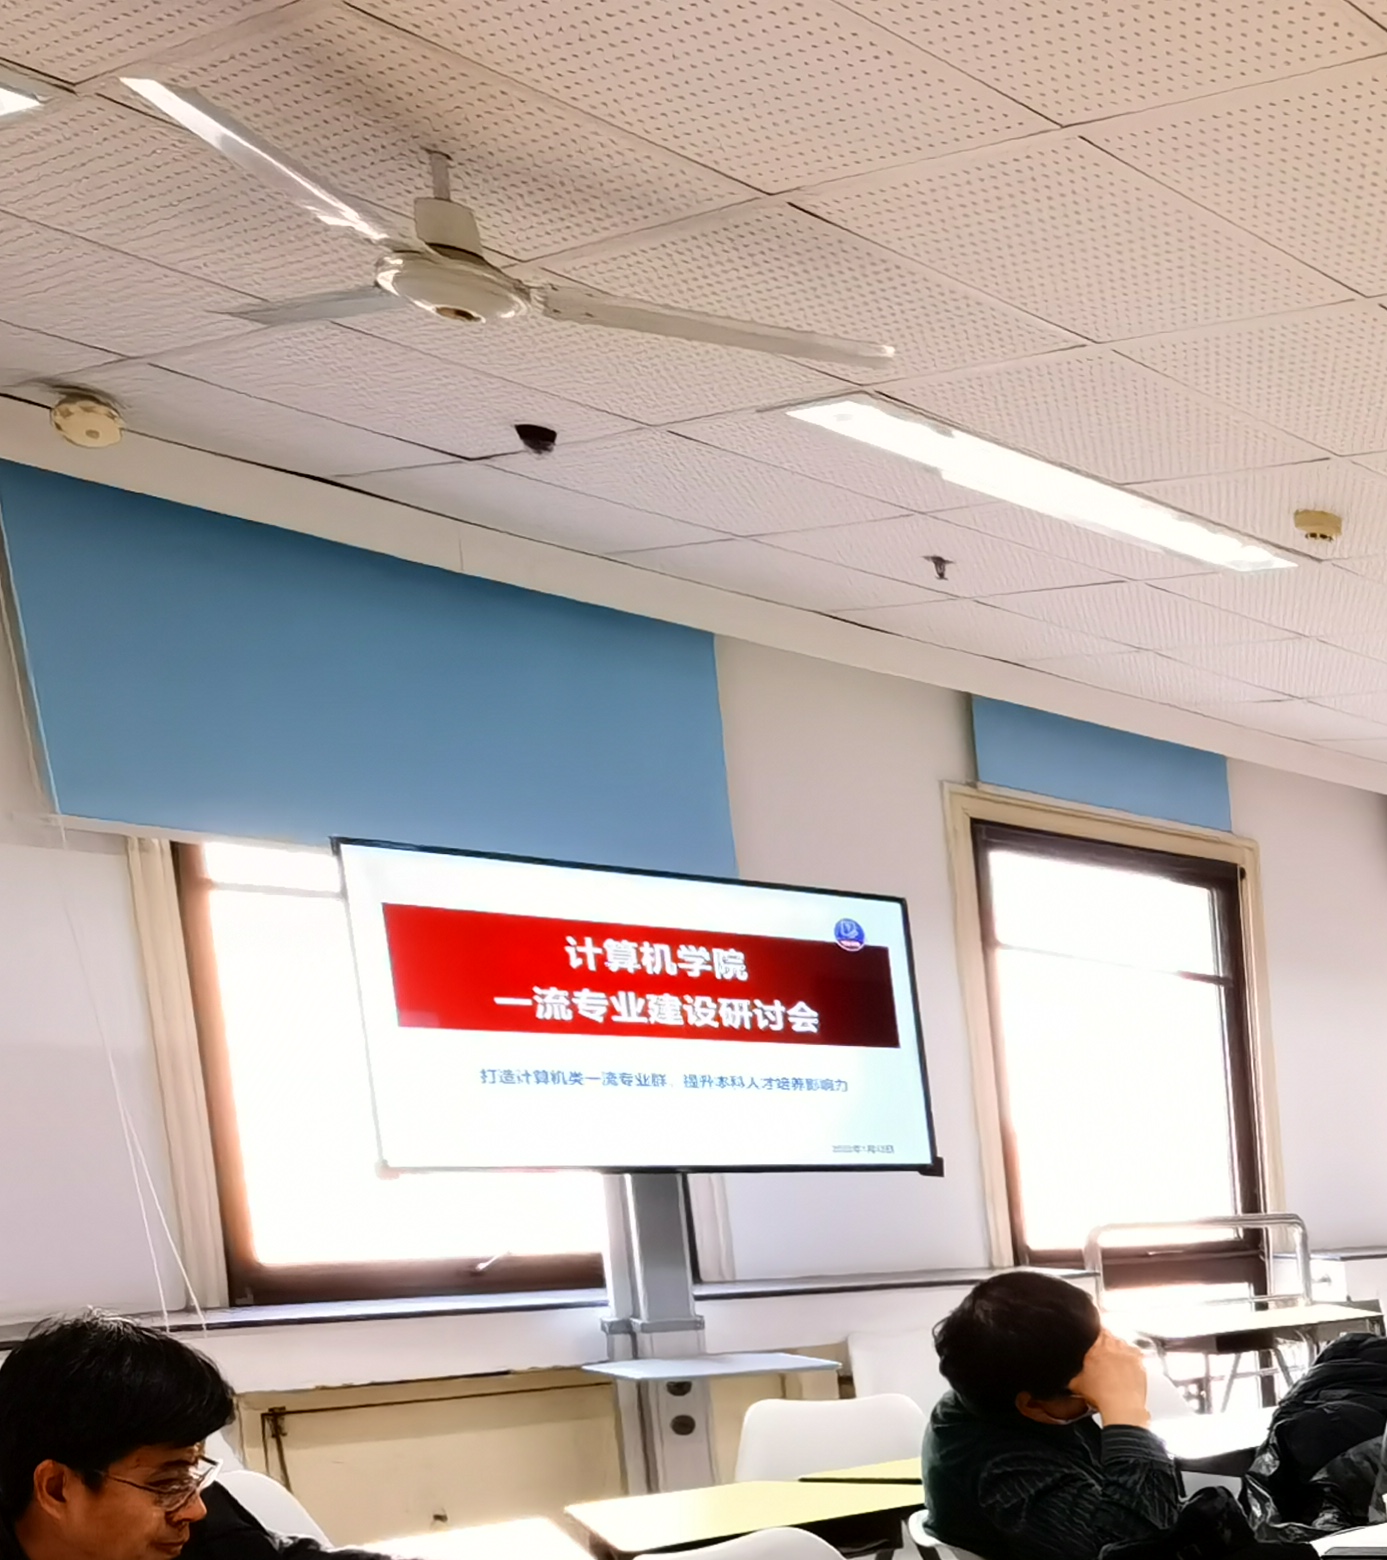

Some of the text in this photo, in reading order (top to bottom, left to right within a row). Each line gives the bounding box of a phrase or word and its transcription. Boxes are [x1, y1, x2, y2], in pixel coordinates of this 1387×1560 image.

[564, 935, 749, 981] 计算机学院
[494, 985, 820, 1035] 一流专业建设研讨会
